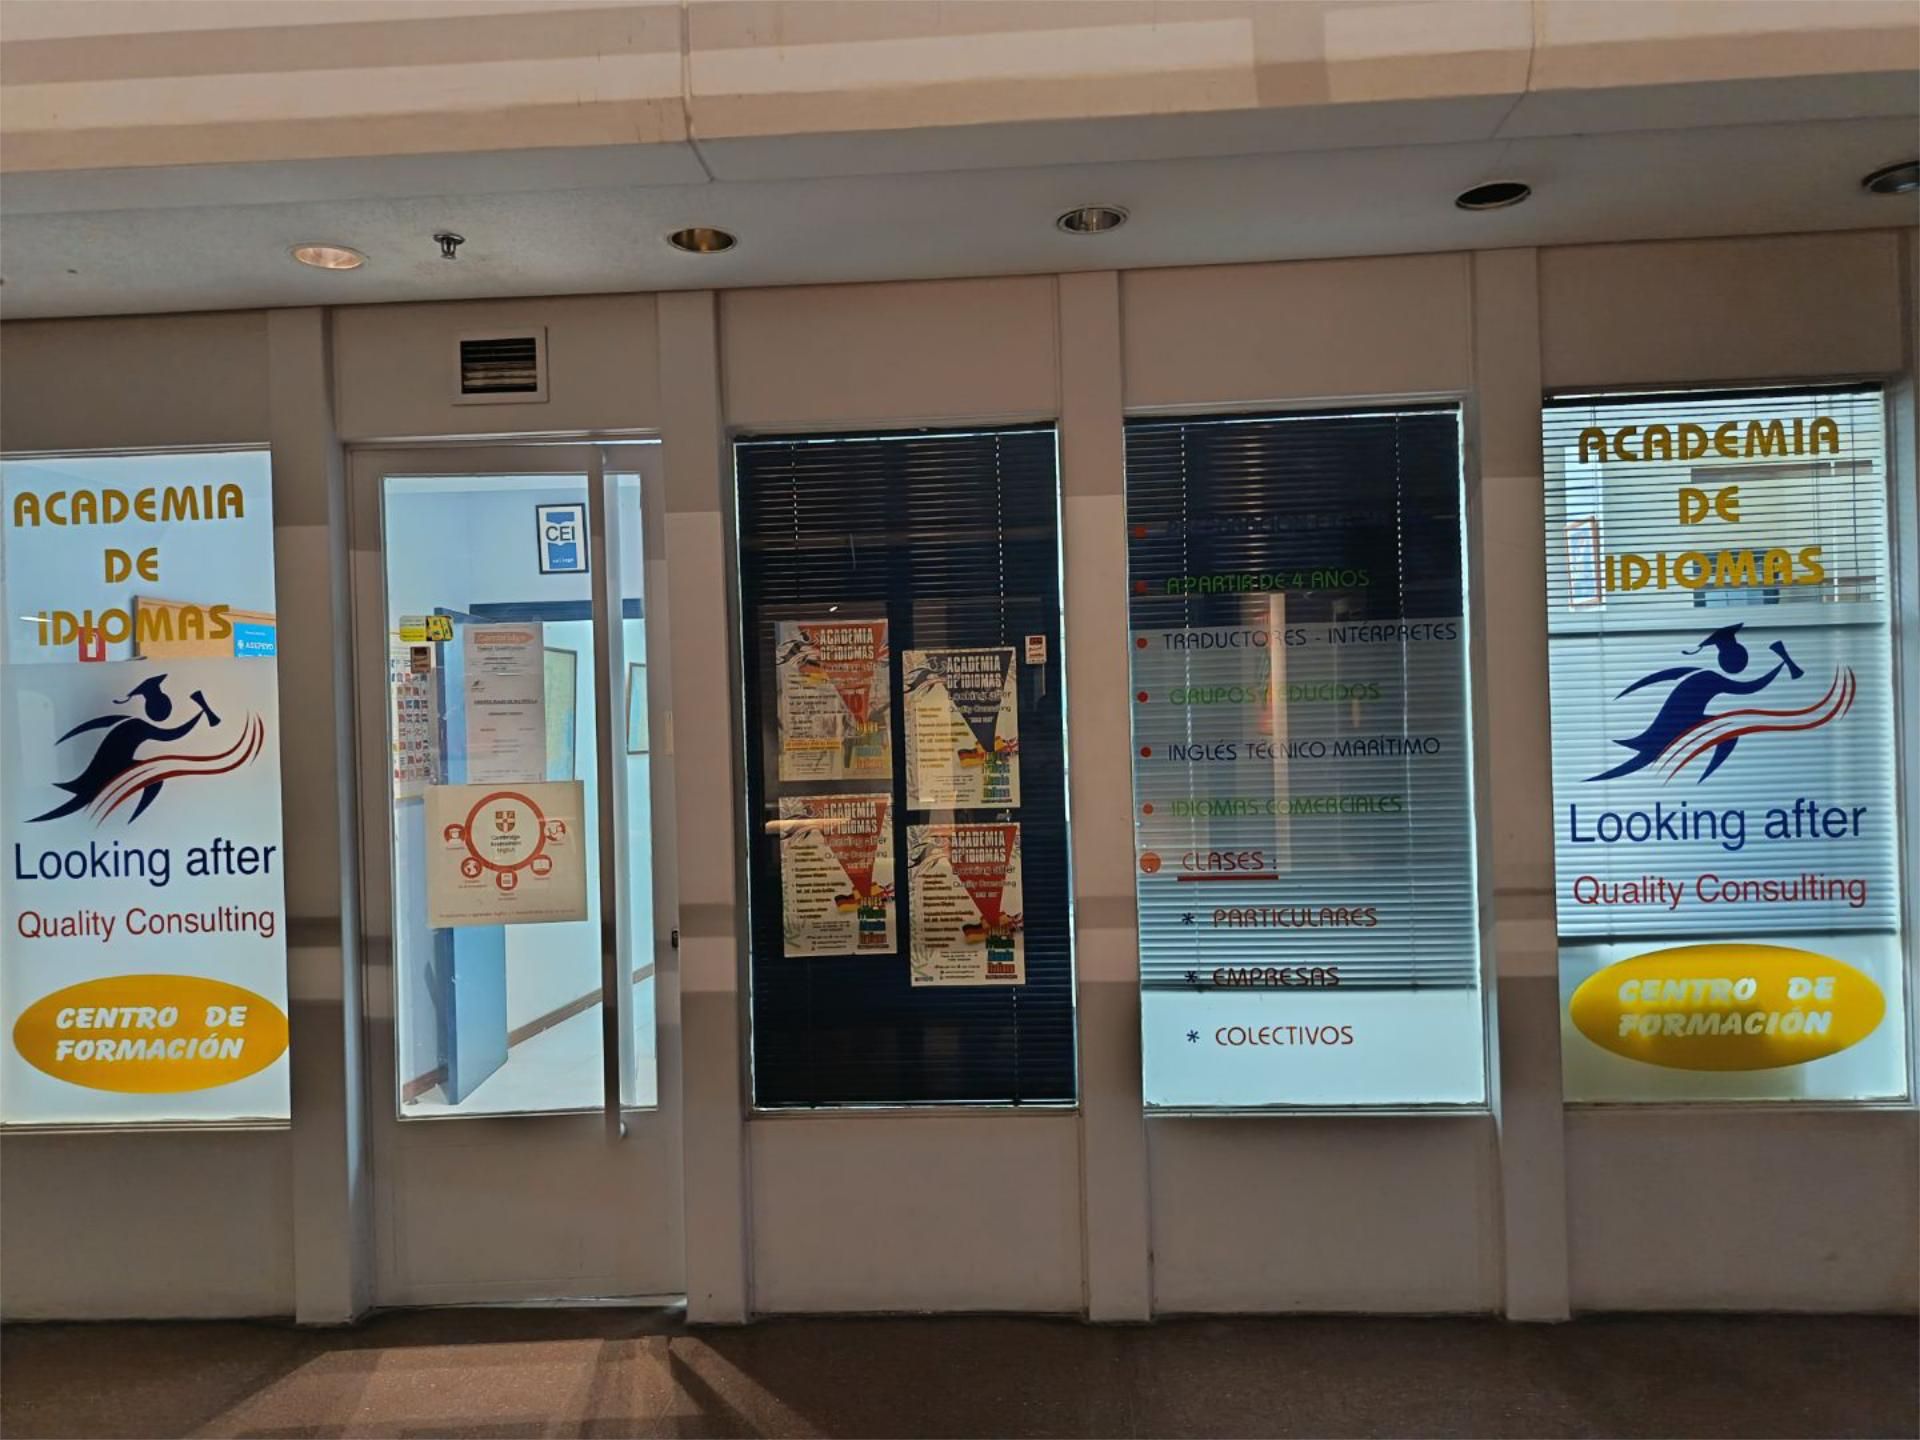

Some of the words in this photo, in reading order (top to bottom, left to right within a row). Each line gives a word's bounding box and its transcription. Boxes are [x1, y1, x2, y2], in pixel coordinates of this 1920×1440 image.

[1579, 415, 1840, 464] ACADEMIA
[14, 483, 246, 527] ACADEMIA
[1678, 485, 1740, 525] DE
[545, 525, 576, 541] CEI
[104, 547, 159, 583] DE
[1605, 545, 1826, 592] IDIOMAS
[1167, 577, 1181, 595] A
[1260, 574, 1285, 591] DE
[1291, 573, 1304, 588] 4
[1311, 566, 1371, 589] AÑOS
[38, 604, 232, 646] IDIOMAS
[820, 628, 874, 644] ACADEMIA
[1163, 628, 1307, 650] TRADUCTORES
[1328, 621, 1457, 644] INTÉRPRETES
[834, 646, 874, 660] IDIOMAS
[947, 655, 1000, 672] ACADEMIA
[947, 674, 960, 688] DE
[961, 673, 1001, 688] IDIOMAS
[1169, 685, 1257, 705] GRUPOS
[1168, 739, 1238, 761] INGLÉS
[1333, 734, 1441, 759] MARÍTIMO
[824, 801, 876, 819] ACADEMIA
[1172, 799, 1258, 817] IDIOMAS
[1266, 794, 1403, 815] COMERCIALES
[837, 819, 878, 834] IDIOMAS
[1569, 801, 1746, 851] Looking
[1764, 798, 1867, 839] after
[951, 830, 1005, 847] ACADEMIA
[15, 840, 170, 887] Looking
[187, 837, 276, 876] after
[965, 848, 1006, 863] IDIOMAS
[1182, 851, 1264, 871] CLASES
[1573, 876, 1685, 910] Quality
[1696, 873, 1867, 908] Consulting
[18, 910, 116, 943] Quality
[126, 906, 275, 938] Consulting
[1213, 907, 1378, 927] PARTICULARES
[1213, 966, 1340, 987] EMPRESAS
[1618, 977, 1757, 1002] CENTRO
[1787, 976, 1837, 1001] DE
[56, 1006, 178, 1029] CENTRO
[205, 1006, 248, 1028] DE
[1618, 1008, 1832, 1038] FORMACIÓN
[55, 1033, 244, 1062] FORMACIÓN
[1215, 1025, 1354, 1046] COLECTIVOS
